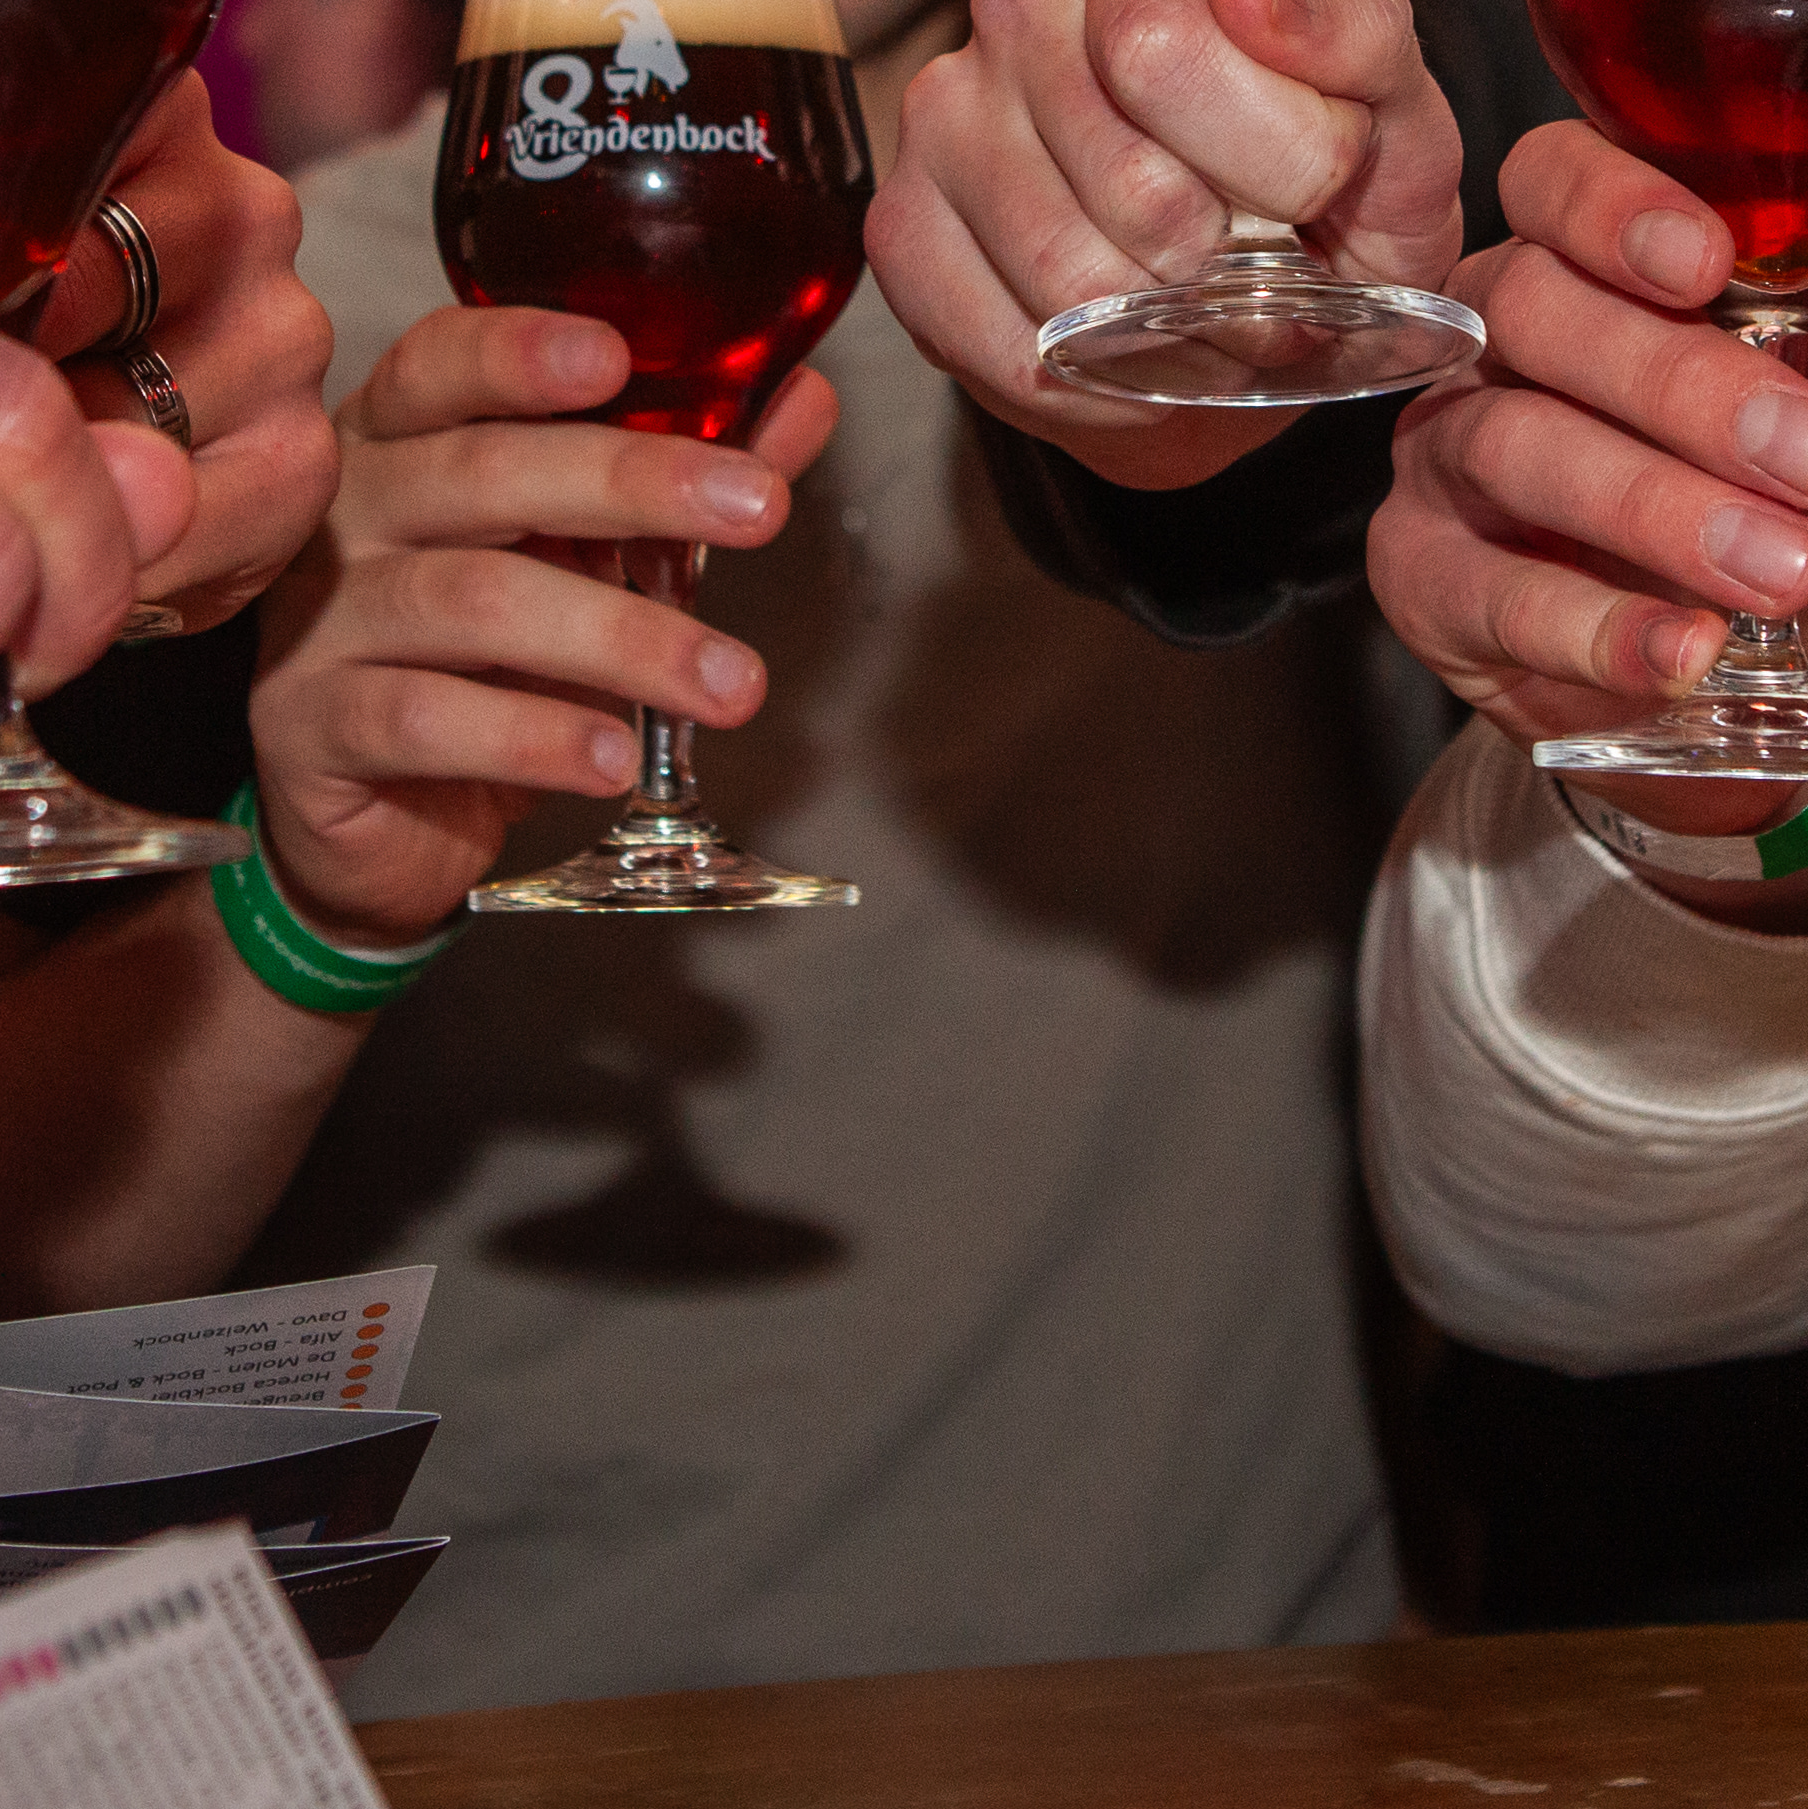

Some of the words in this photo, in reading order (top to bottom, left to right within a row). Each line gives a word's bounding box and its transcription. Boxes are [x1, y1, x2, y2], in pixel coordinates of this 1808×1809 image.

[505, 113, 776, 161] Vriendenbock
[291, 1308, 348, 1328] Davo
[132, 1321, 270, 1350] Weizenbock
[299, 1329, 344, 1348] Alfa
[224, 1339, 277, 1358] Bock
[306, 1349, 337, 1366] De
[227, 1355, 300, 1377] Molen
[66, 1379, 120, 1397] Poot
[127, 1376, 146, 1391] &
[152, 1368, 206, 1388] Bock
[253, 1370, 332, 1391] Horeca
